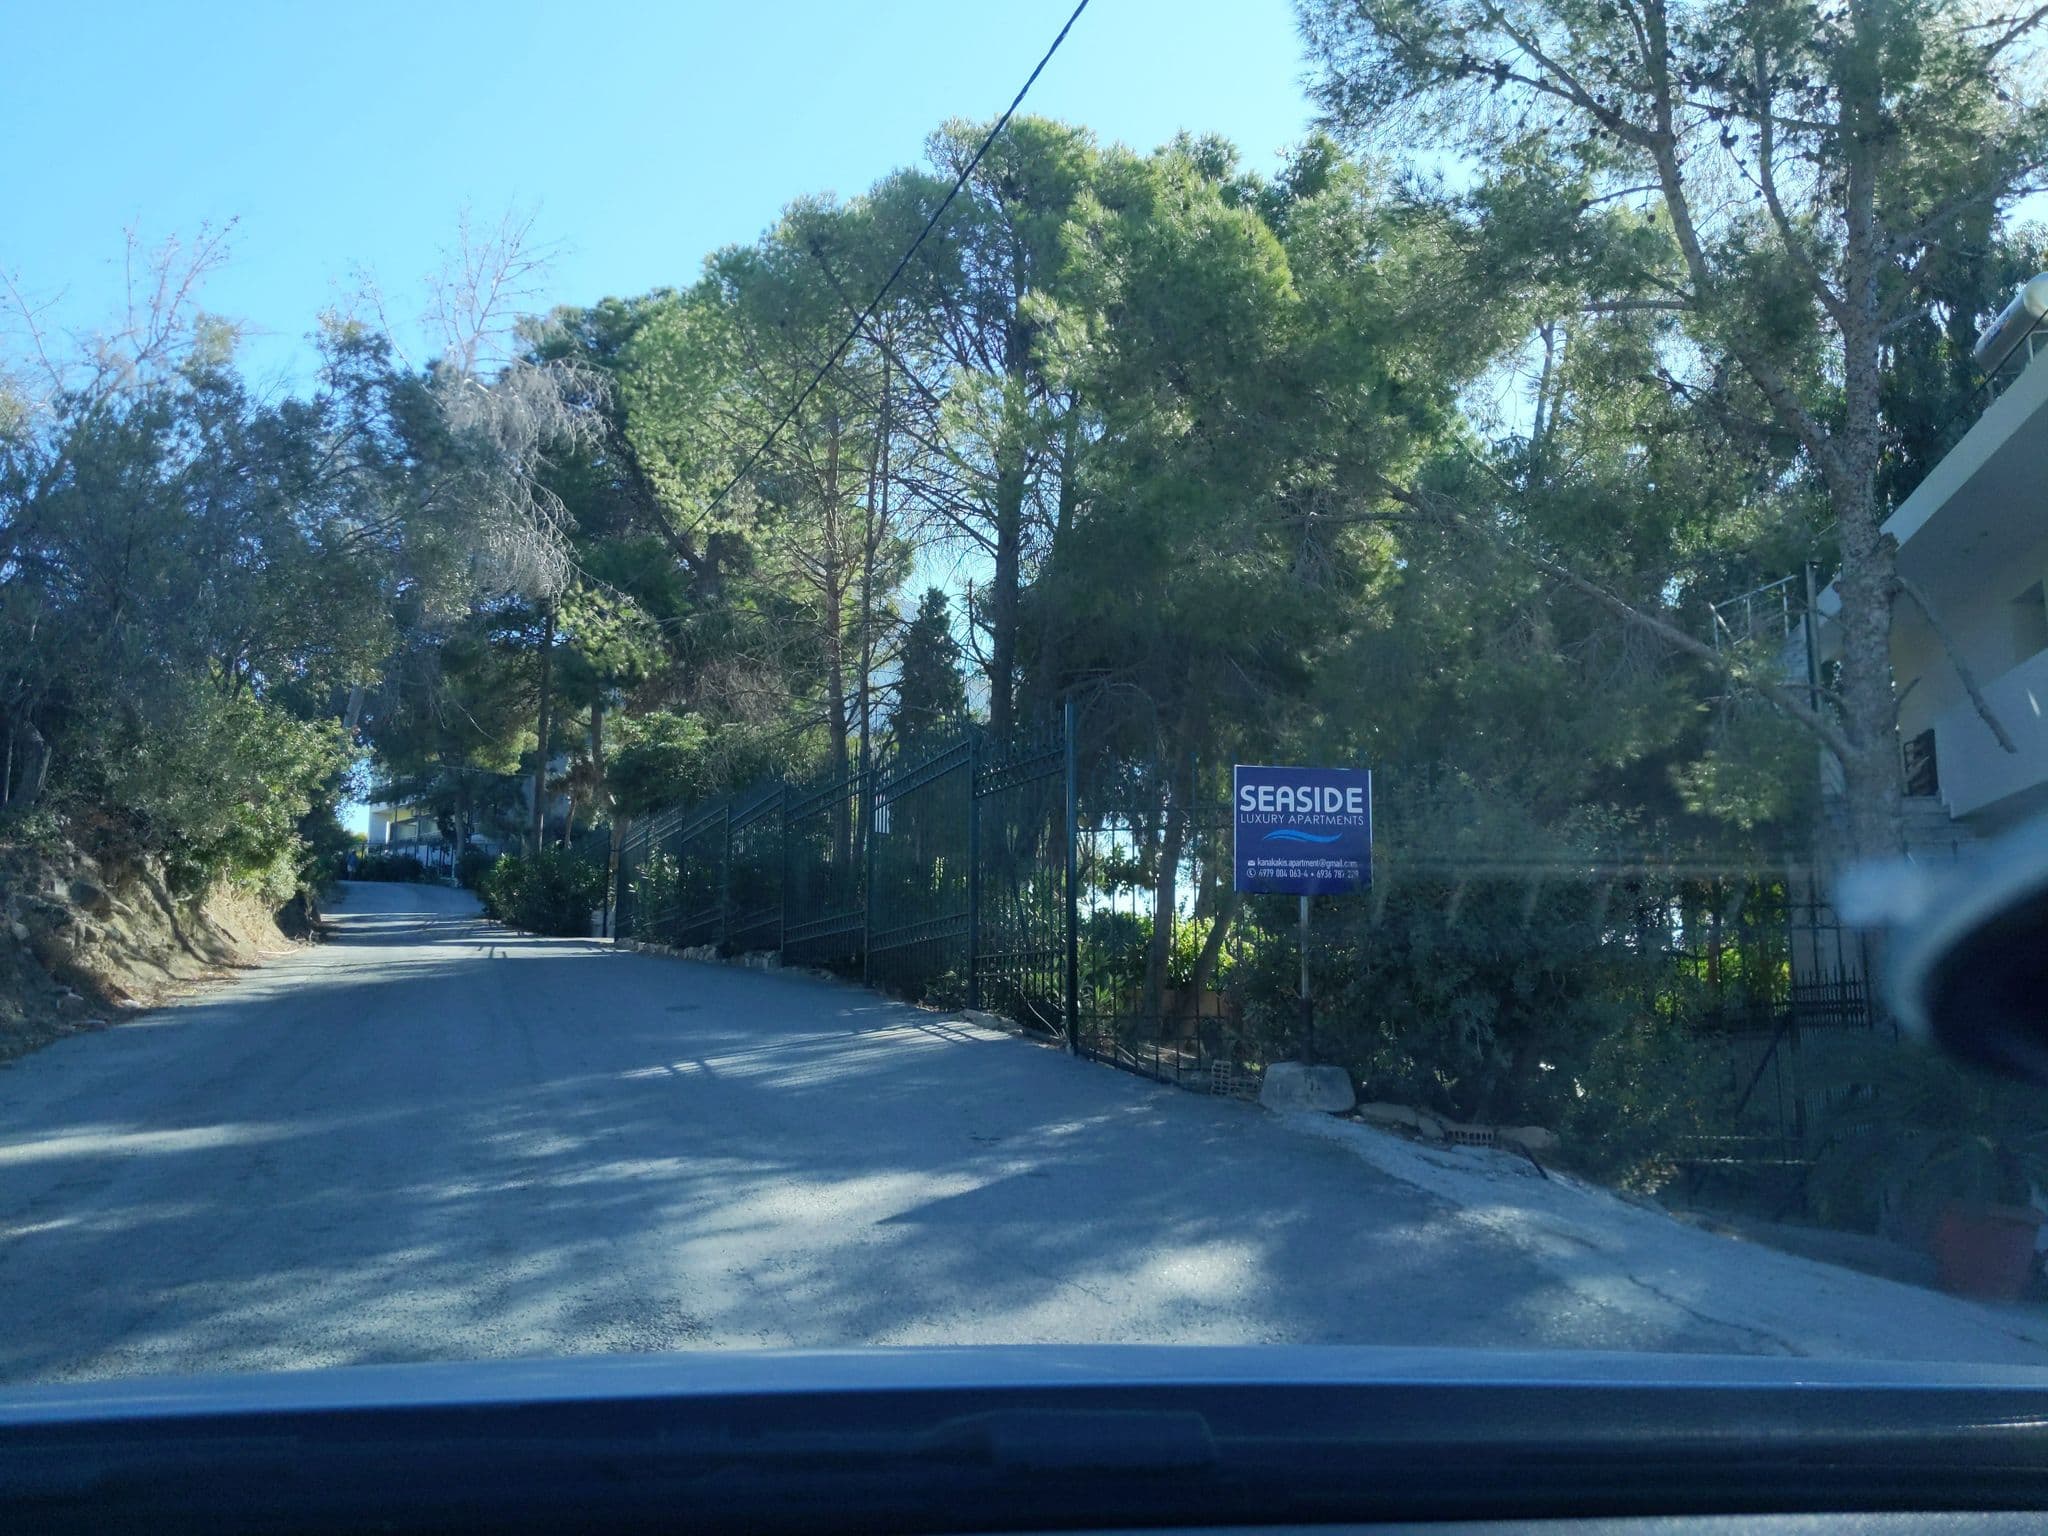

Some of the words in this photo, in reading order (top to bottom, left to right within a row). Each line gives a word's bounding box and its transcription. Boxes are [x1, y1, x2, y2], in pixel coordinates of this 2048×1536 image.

[1239, 785, 1364, 814] SEASIDE
[1240, 813, 1284, 824] LUXURY
[1288, 814, 1364, 826] APARTMENTS
